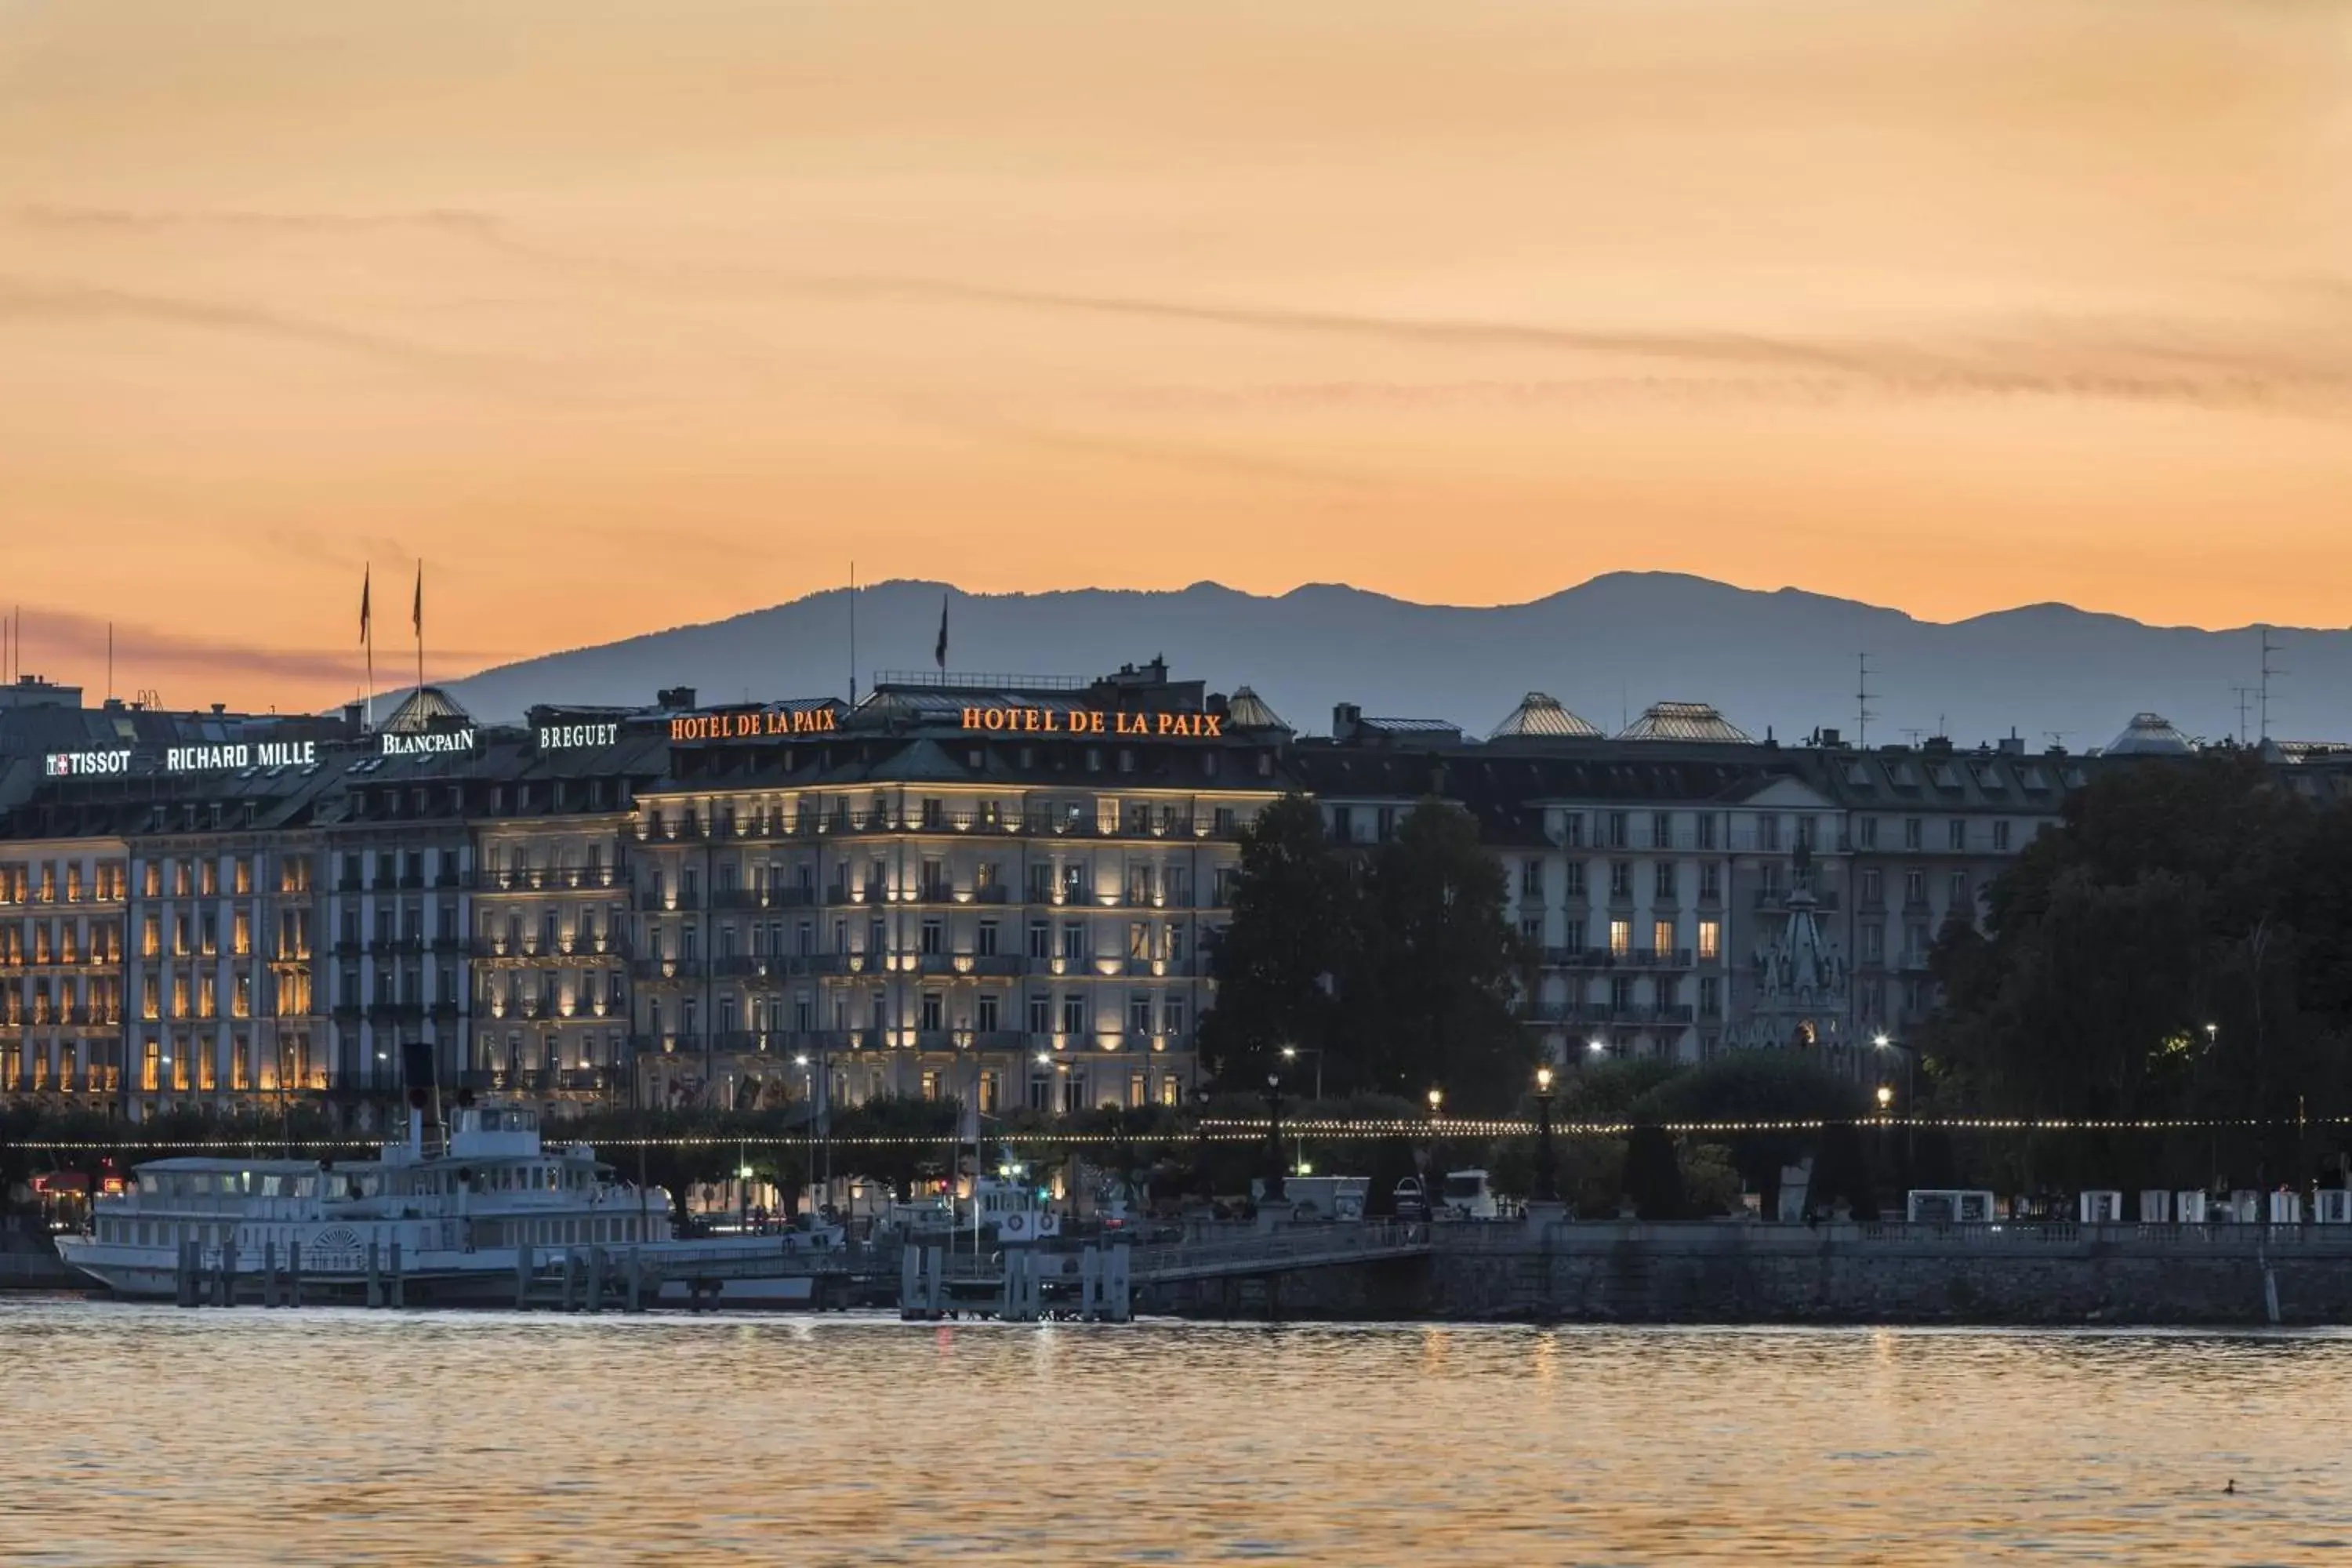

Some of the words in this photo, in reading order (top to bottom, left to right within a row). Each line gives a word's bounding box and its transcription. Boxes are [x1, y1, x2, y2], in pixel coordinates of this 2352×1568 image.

[671, 715, 731, 740] HOTEL
[737, 714, 761, 736] DE
[768, 711, 789, 733] LA
[793, 708, 835, 732] PAIX
[962, 707, 1058, 731] HOTEL
[1069, 711, 1105, 732] DE
[1116, 712, 1149, 734] LA
[1158, 713, 1221, 736] PAIX
[382, 729, 474, 754] BLANCPAIN
[541, 724, 617, 748] BREGUET
[69, 750, 131, 774] TISSOT
[167, 746, 249, 771] RICHARD
[258, 741, 314, 766] MILLE
